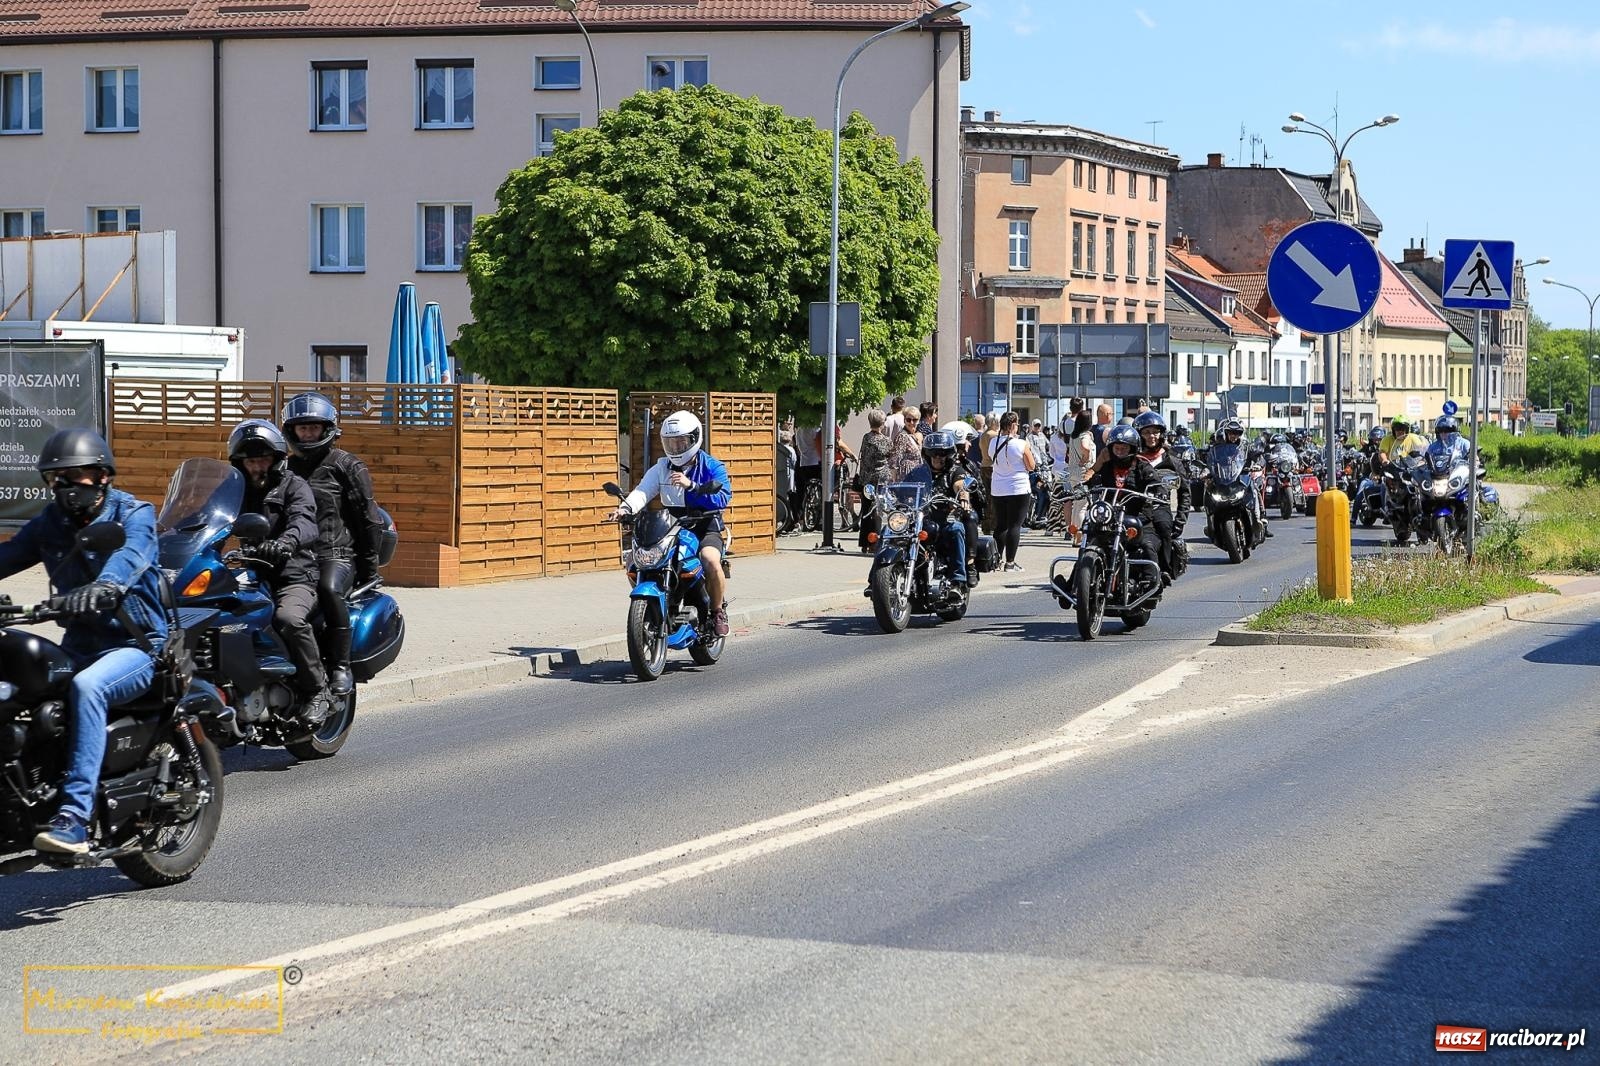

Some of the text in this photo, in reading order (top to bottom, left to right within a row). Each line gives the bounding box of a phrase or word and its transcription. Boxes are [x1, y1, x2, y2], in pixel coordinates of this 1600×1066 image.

[0, 373, 80, 388] PRASZAMY!
[0, 406, 40, 416] iedziałek
[46, 406, 76, 416] sobota
[18, 418, 42, 428] 23.00
[0, 442, 25, 452] dziela
[23, 487, 47, 500] 891
